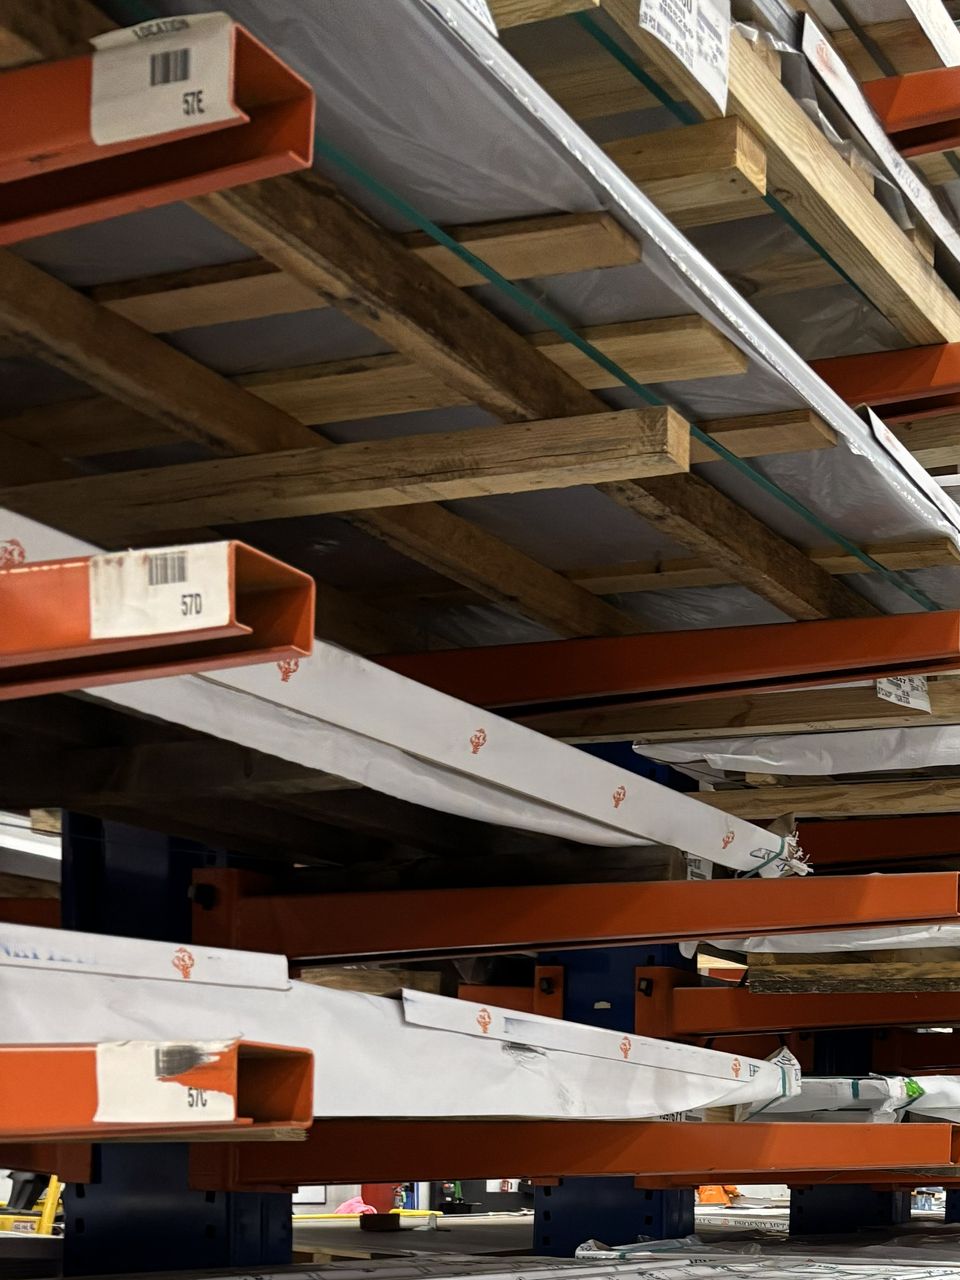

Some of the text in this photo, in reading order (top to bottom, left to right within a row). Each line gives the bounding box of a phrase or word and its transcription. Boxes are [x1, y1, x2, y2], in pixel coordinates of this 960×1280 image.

[182, 89, 205, 116] 57E
[181, 592, 202, 616] 57D
[187, 1086, 207, 1108] 57C
